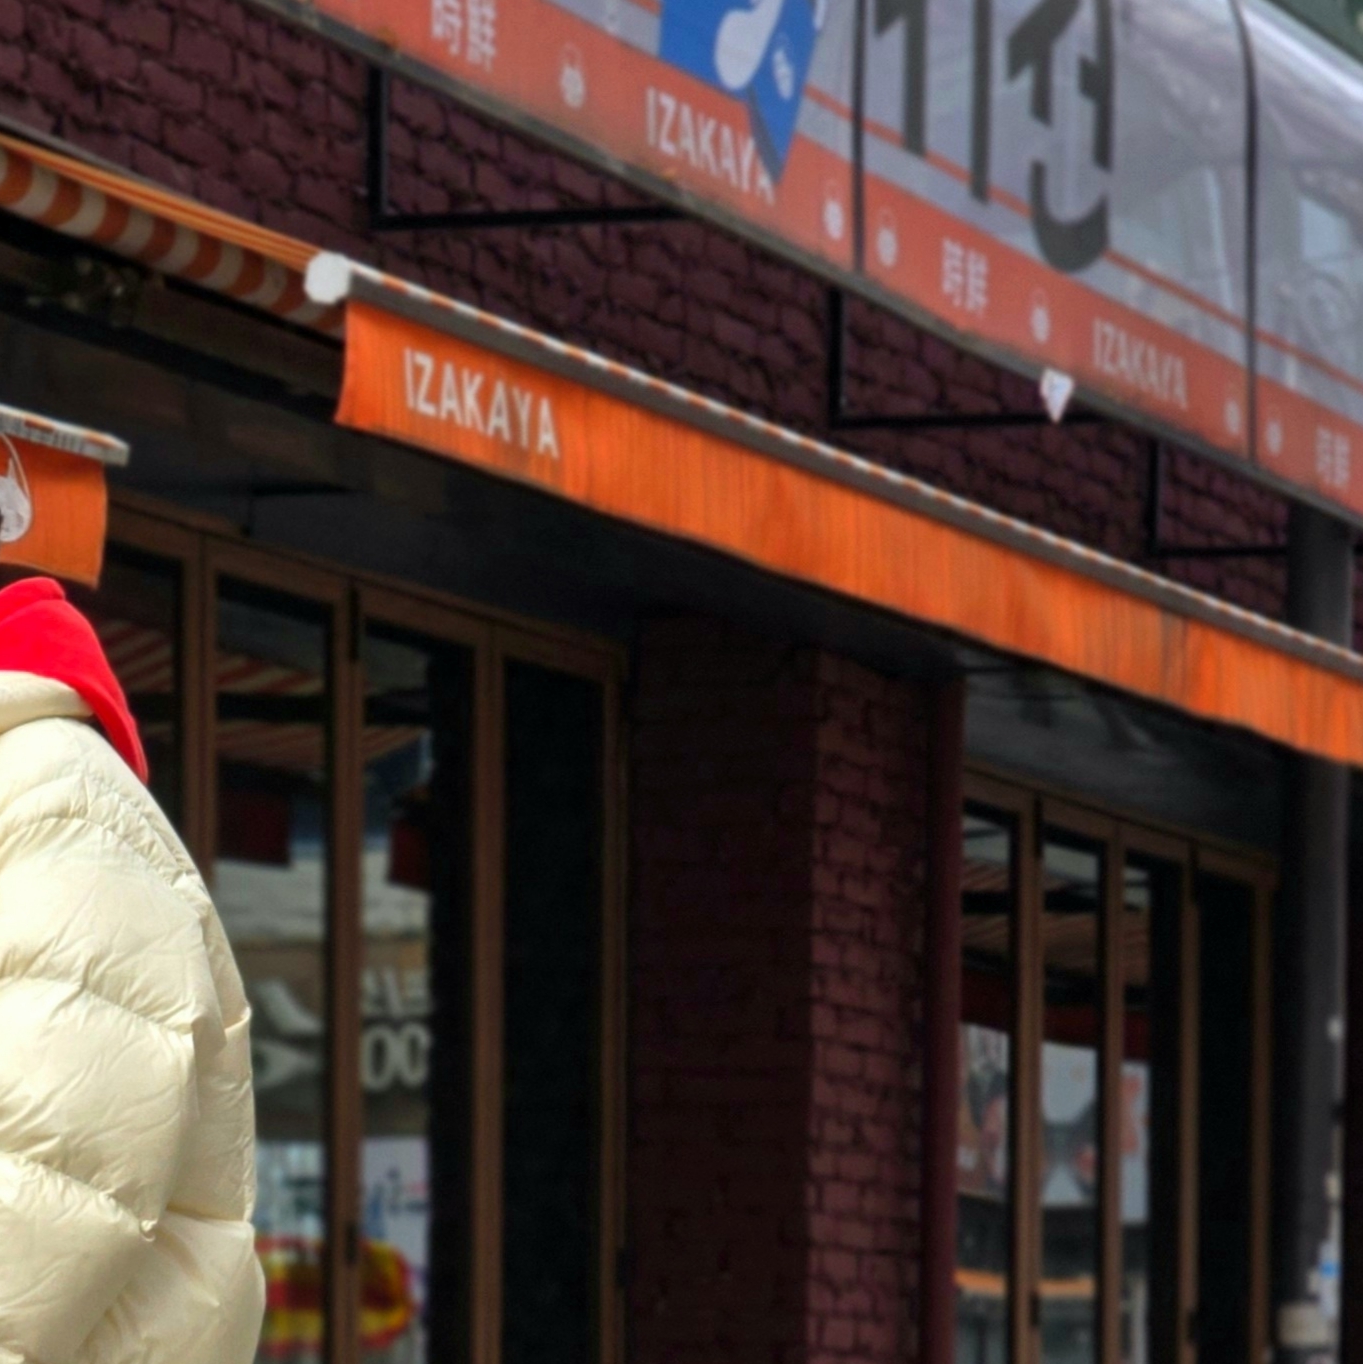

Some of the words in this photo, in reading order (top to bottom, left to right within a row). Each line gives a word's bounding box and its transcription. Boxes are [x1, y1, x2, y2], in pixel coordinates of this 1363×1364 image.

[645, 84, 775, 207] IZAKAYA
[404, 347, 561, 459] IZAKAYA
[1092, 317, 1188, 411] IZAKAYA
